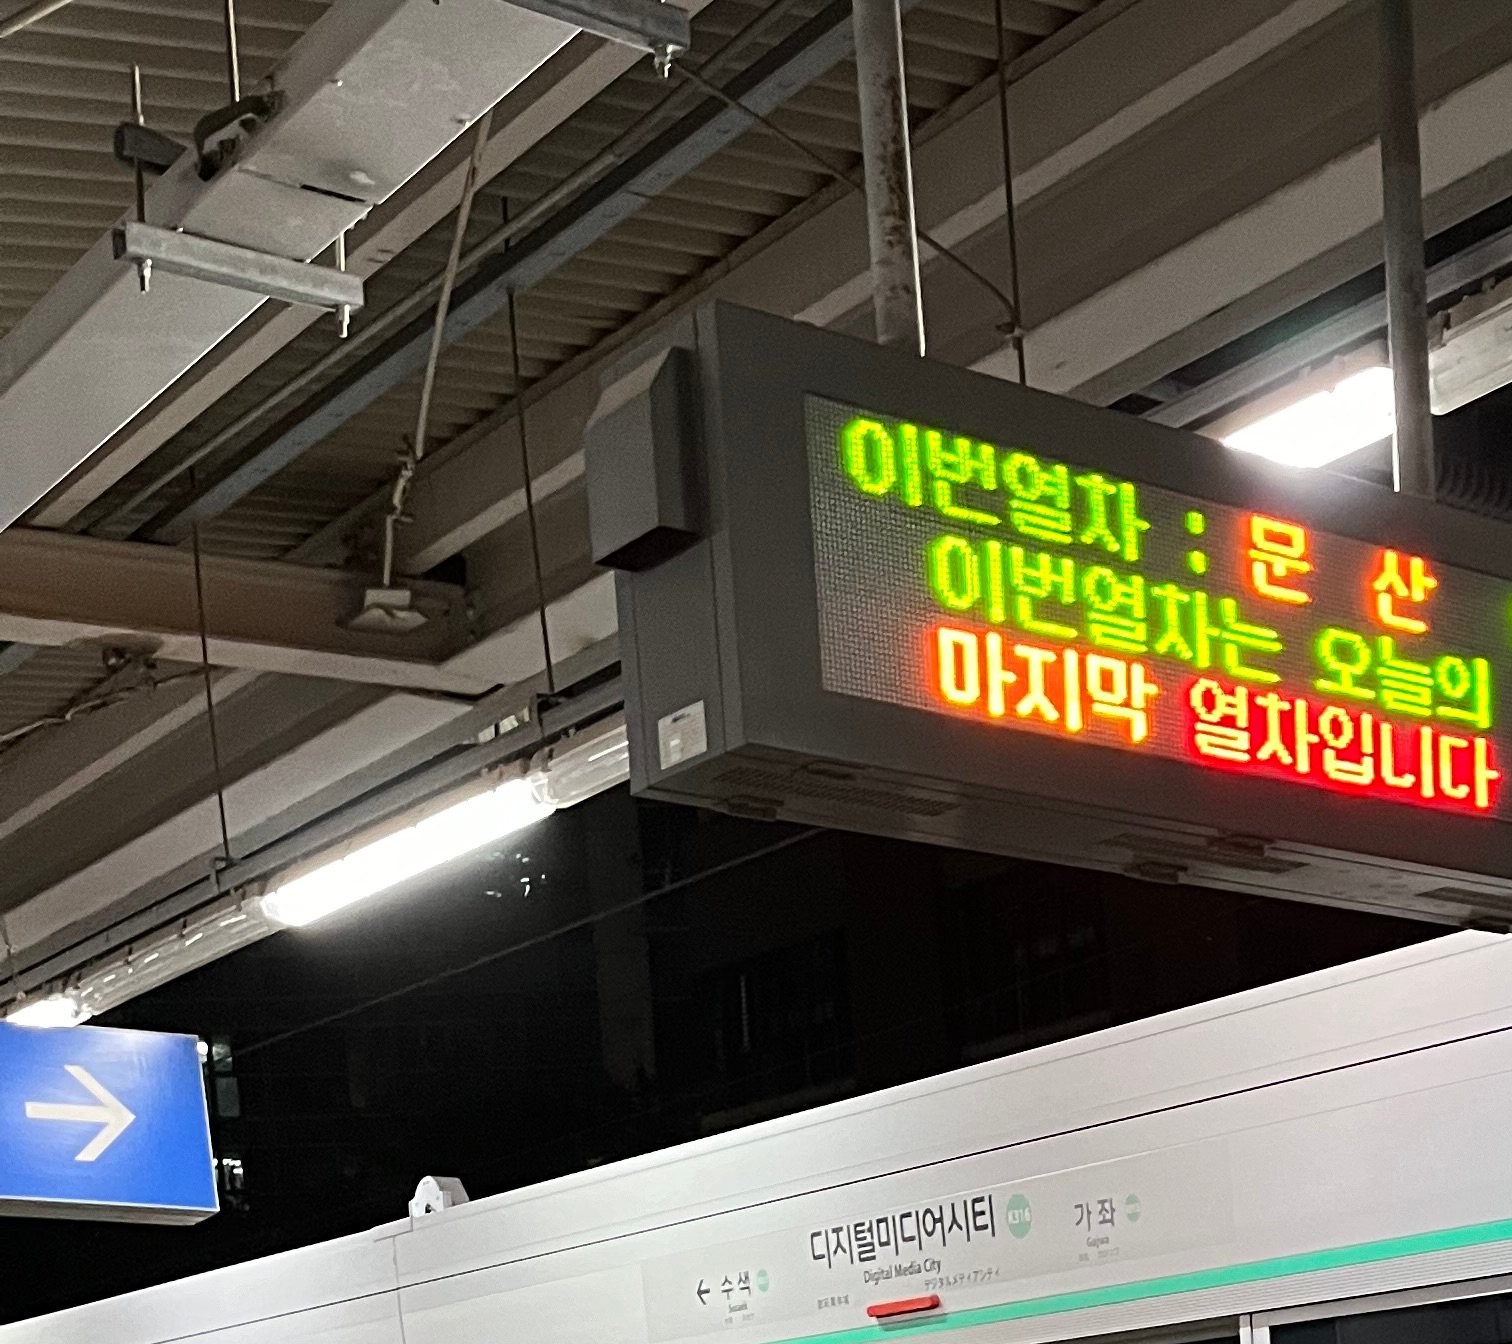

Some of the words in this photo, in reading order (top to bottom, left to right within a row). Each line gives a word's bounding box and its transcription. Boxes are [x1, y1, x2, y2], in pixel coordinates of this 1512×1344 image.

[840, 416, 1151, 562] 이번열차
[1248, 513, 1314, 605] 문
[1372, 548, 1438, 635] 산
[928, 535, 1284, 685] 이번열차는
[1313, 627, 1493, 730] 오늘의
[937, 626, 1159, 744] 마지막
[1189, 678, 1501, 809] 열차입니다
[810, 1194, 996, 1269] 디지털미디어시티
[1007, 1207, 1031, 1225] K316
[1074, 1197, 1115, 1232] 가좌
[720, 1271, 752, 1301] 수색
[863, 1263, 893, 1286] Digital
[894, 1260, 922, 1280] Media
[923, 1257, 942, 1274] City
